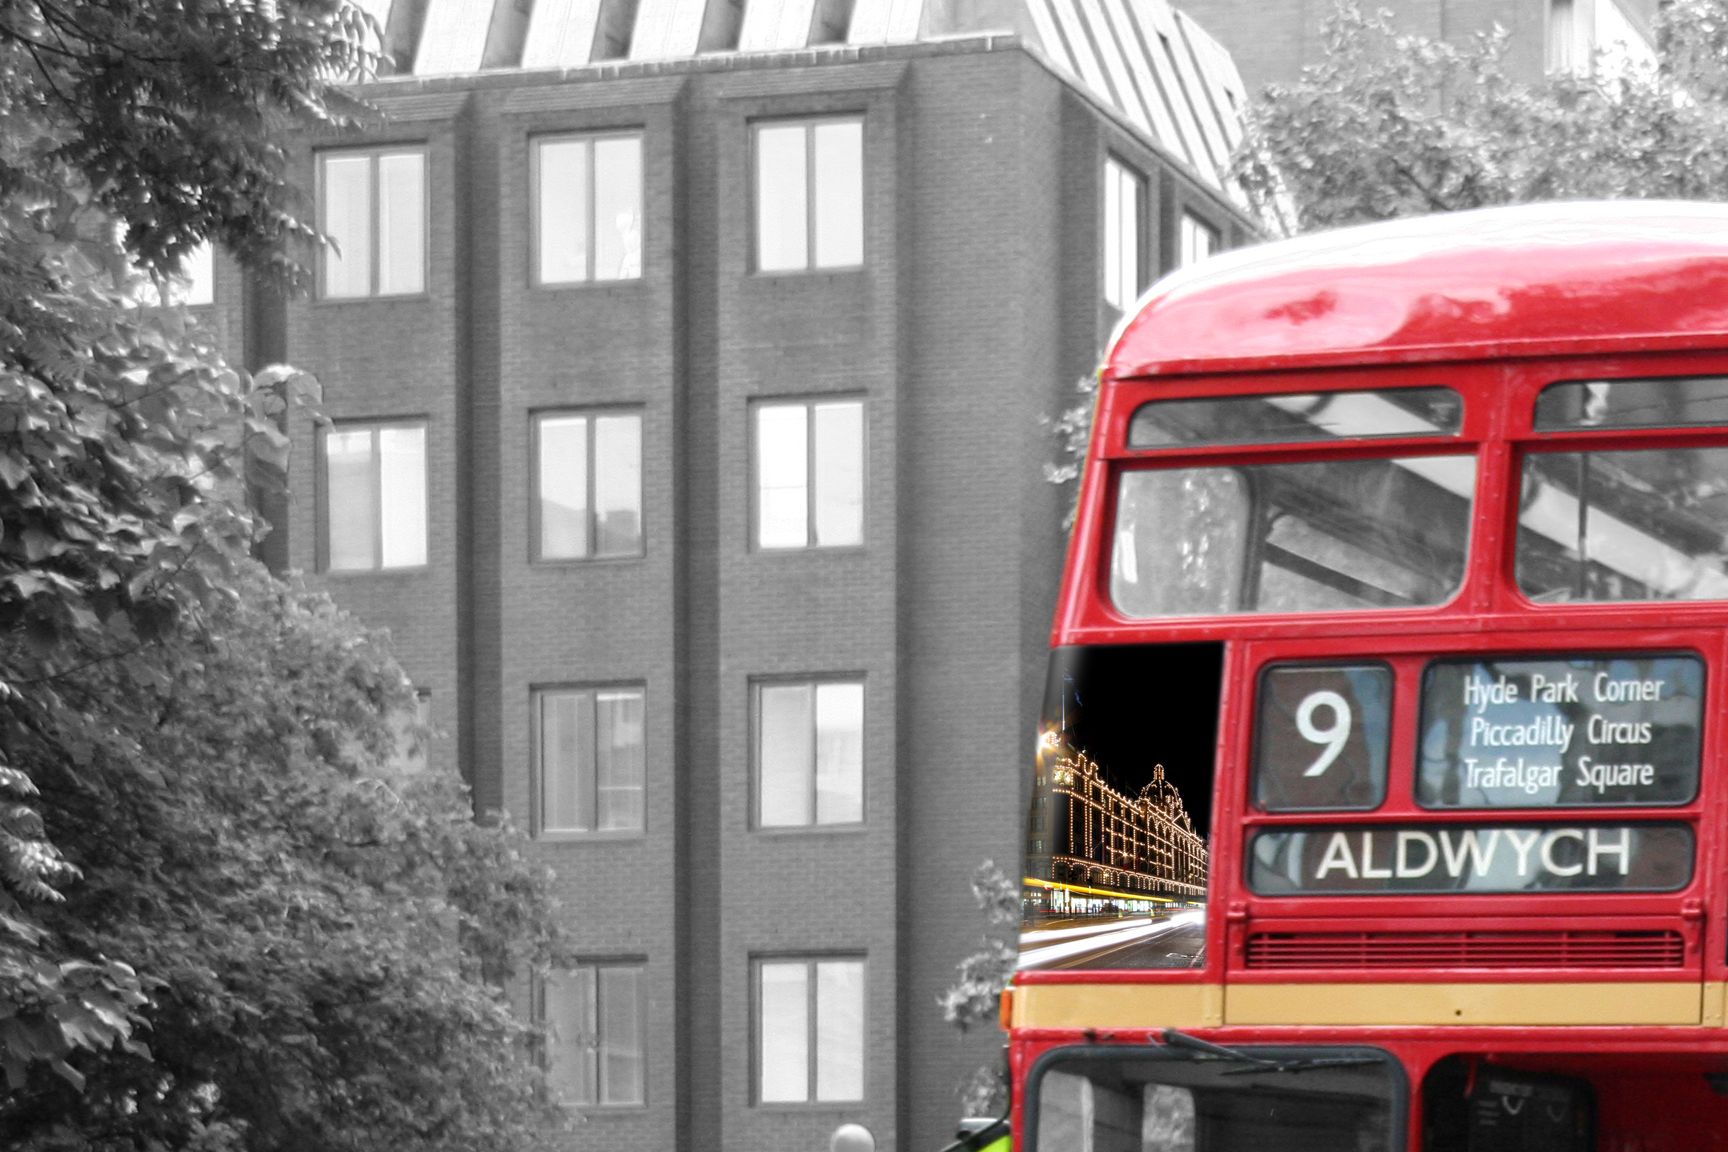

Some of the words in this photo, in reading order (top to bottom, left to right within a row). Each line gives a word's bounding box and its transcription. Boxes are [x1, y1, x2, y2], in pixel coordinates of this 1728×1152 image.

[1463, 675, 1518, 714] Hyde
[1531, 673, 1580, 703] Park
[1594, 672, 1666, 702] Corner
[1295, 690, 1352, 777] 9
[1470, 715, 1575, 754] Piccadilly
[1587, 714, 1652, 745] Circus
[1464, 757, 1564, 795] Trafalgar
[1576, 756, 1655, 795] Square
[1315, 827, 1630, 880] ALDWYCH
